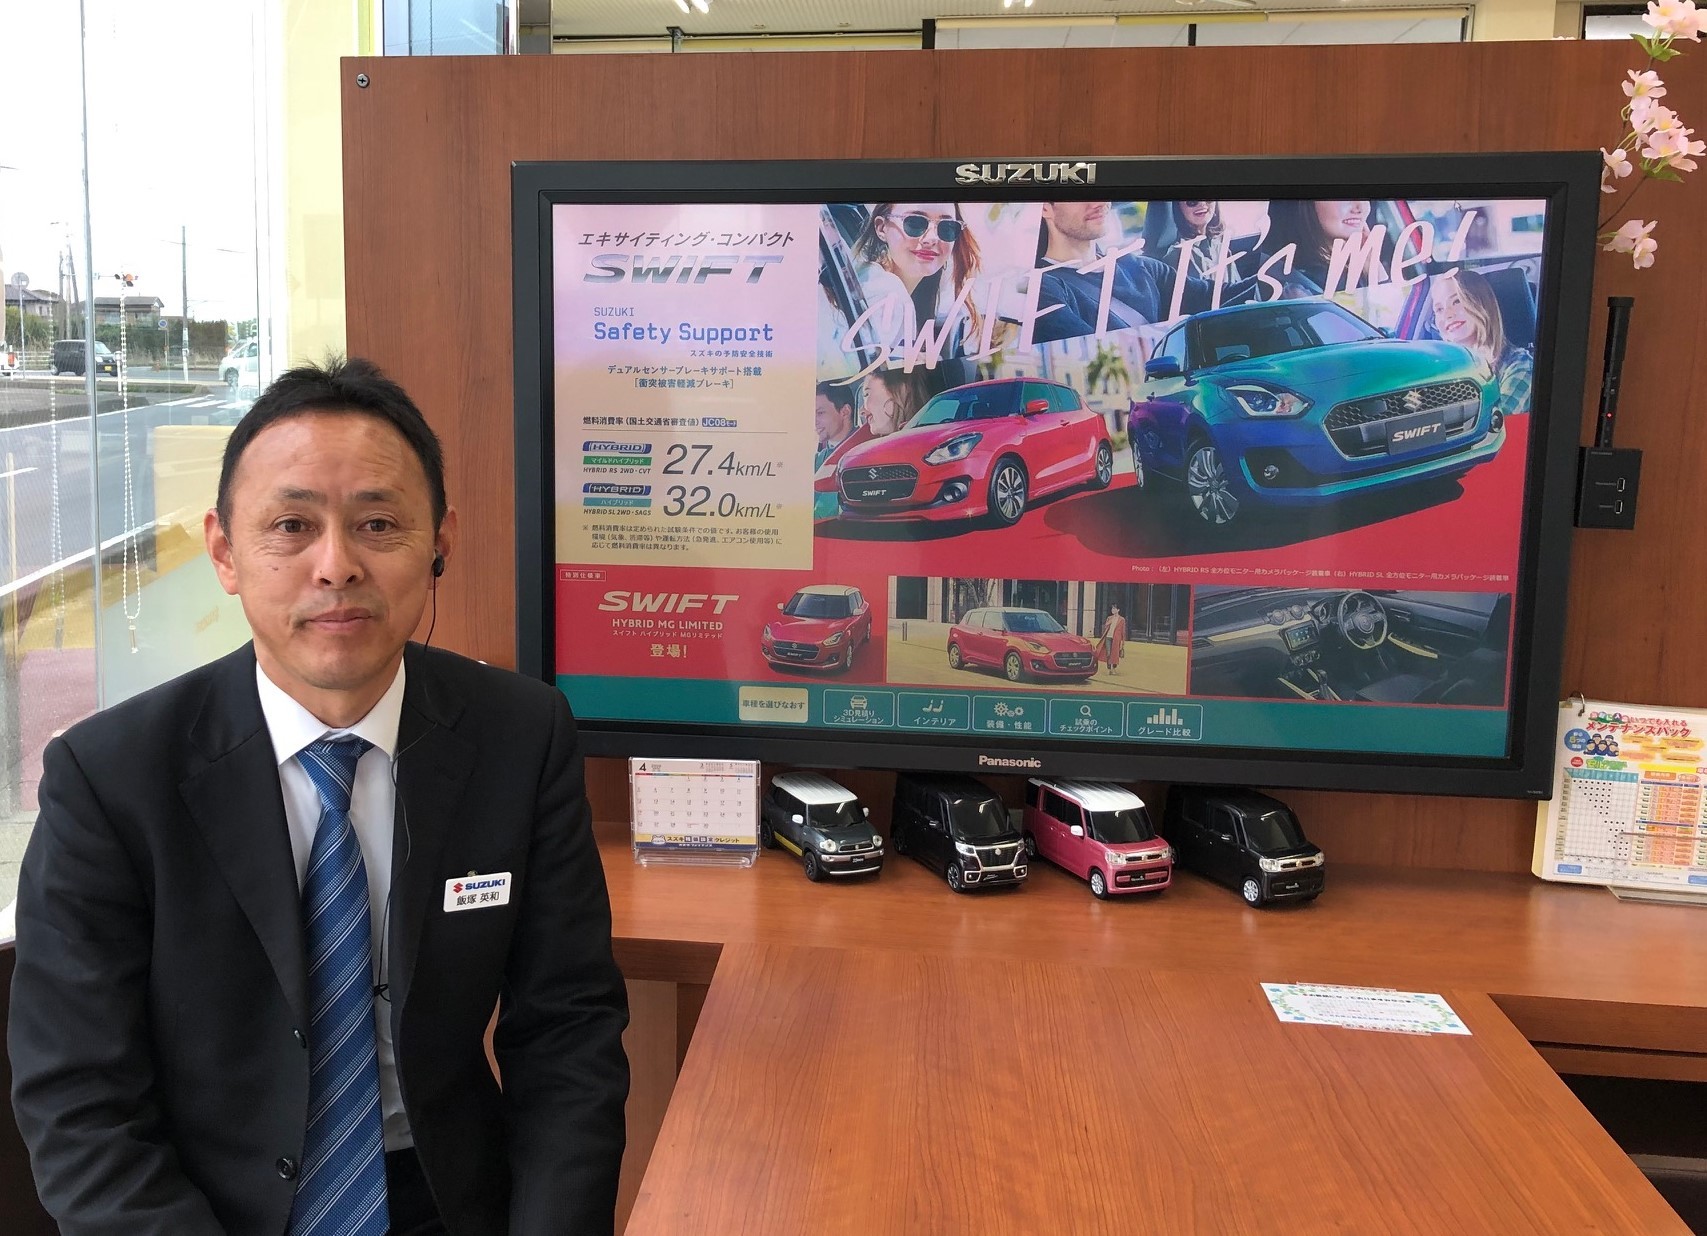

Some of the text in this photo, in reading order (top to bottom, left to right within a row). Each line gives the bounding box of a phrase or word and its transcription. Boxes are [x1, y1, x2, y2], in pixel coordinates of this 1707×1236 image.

[955, 163, 1096, 185] SUZUKI
[578, 231, 794, 247] エキサイティング・コンパクト
[583, 253, 784, 284] SWIFT
[593, 306, 635, 317] SUZUKI
[594, 321, 773, 345] Safety Support
[690, 349, 773, 358] スズキの予防安全技術
[1392, 423, 1442, 442] SWIFT
[862, 489, 887, 497] SWIFT
[598, 590, 740, 615] SWIFT
[612, 618, 724, 631] HYBRID MG LIMITED
[913, 716, 957, 727] インテリア
[1138, 726, 1192, 738] グレード比較
[1585, 721, 1692, 738] メンテナンスパック
[639, 762, 647, 772] 4
[978, 754, 1042, 769] Panasonic
[465, 878, 506, 891] SUZUKI
[480, 891, 500, 903] 英和
